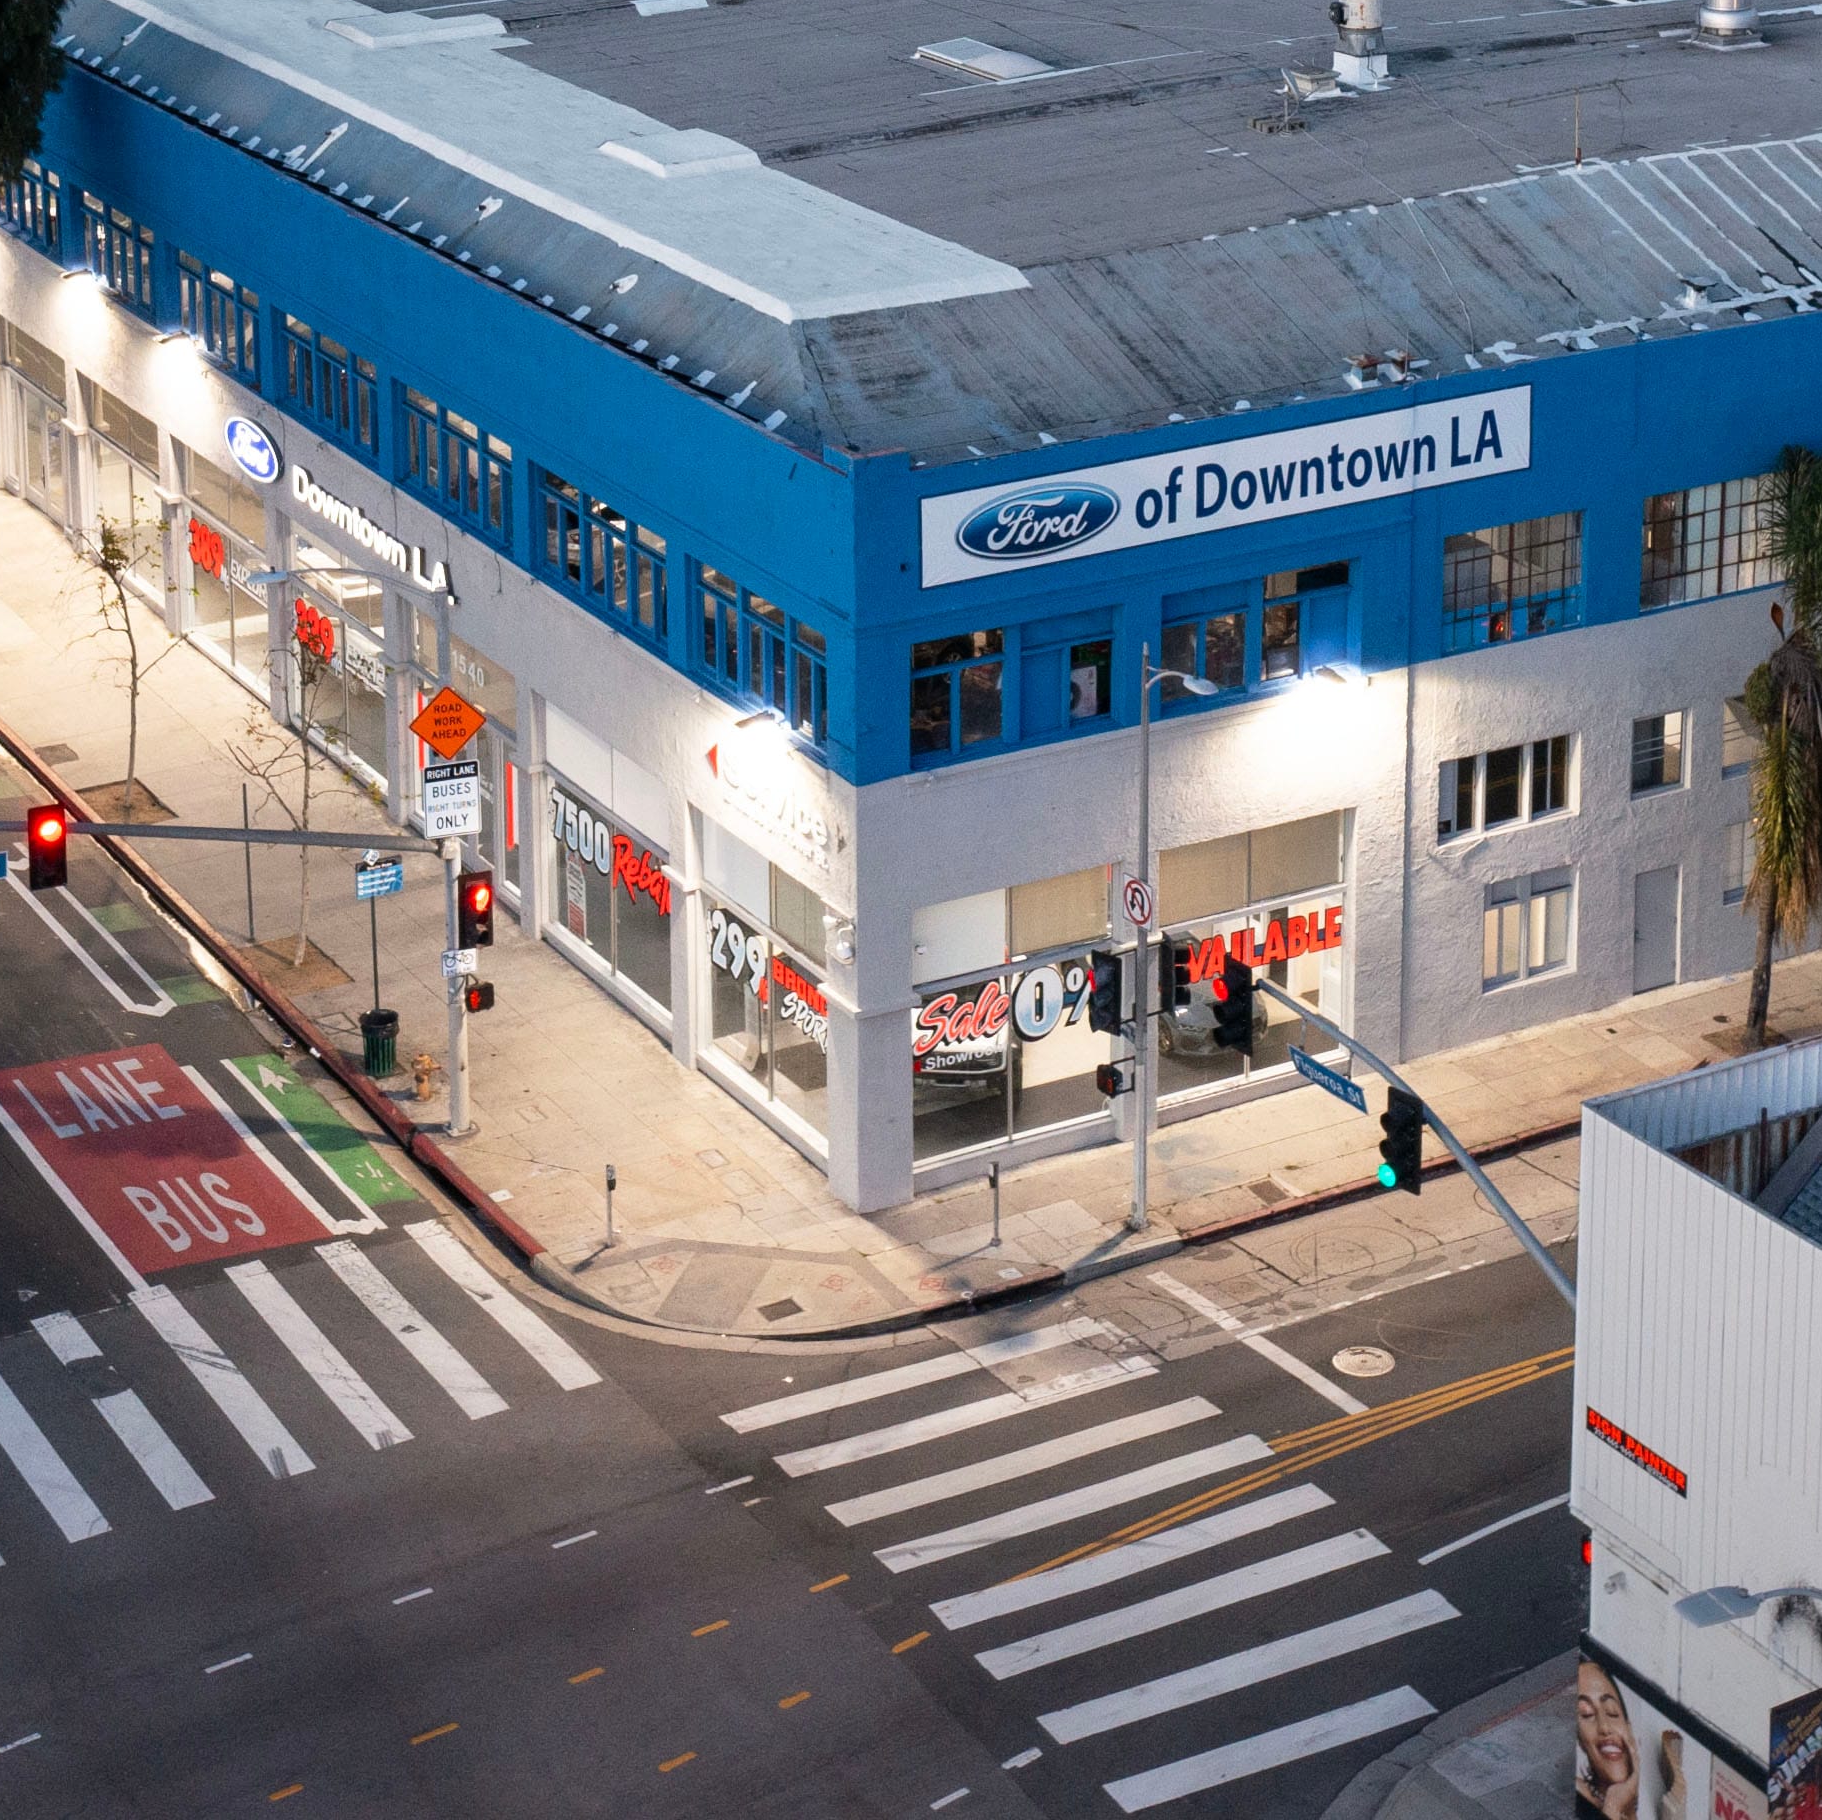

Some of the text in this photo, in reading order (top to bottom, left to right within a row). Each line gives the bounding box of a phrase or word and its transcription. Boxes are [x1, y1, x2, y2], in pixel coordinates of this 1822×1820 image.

[232, 422, 271, 477] Ford
[986, 408, 1503, 551] Ford of Downtown LA
[292, 464, 447, 592] Downtown LA
[451, 650, 485, 688] 1540
[433, 703, 462, 714] ROAD
[434, 716, 463, 727] WORK
[432, 728, 467, 739] AHEAD
[426, 764, 477, 780] RIGHT LANE
[432, 782, 472, 799] BUSES
[427, 799, 477, 814] RIGHT TURNS
[436, 813, 469, 830] ONLY
[913, 974, 1011, 1058] Sale
[12, 1058, 187, 1140] LANE
[1294, 1054, 1362, 1106] Figueroa St
[120, 1172, 268, 1253] BUS
[1588, 1409, 1622, 1444] SIGN
[1625, 1435, 1686, 1491] PAINTER
